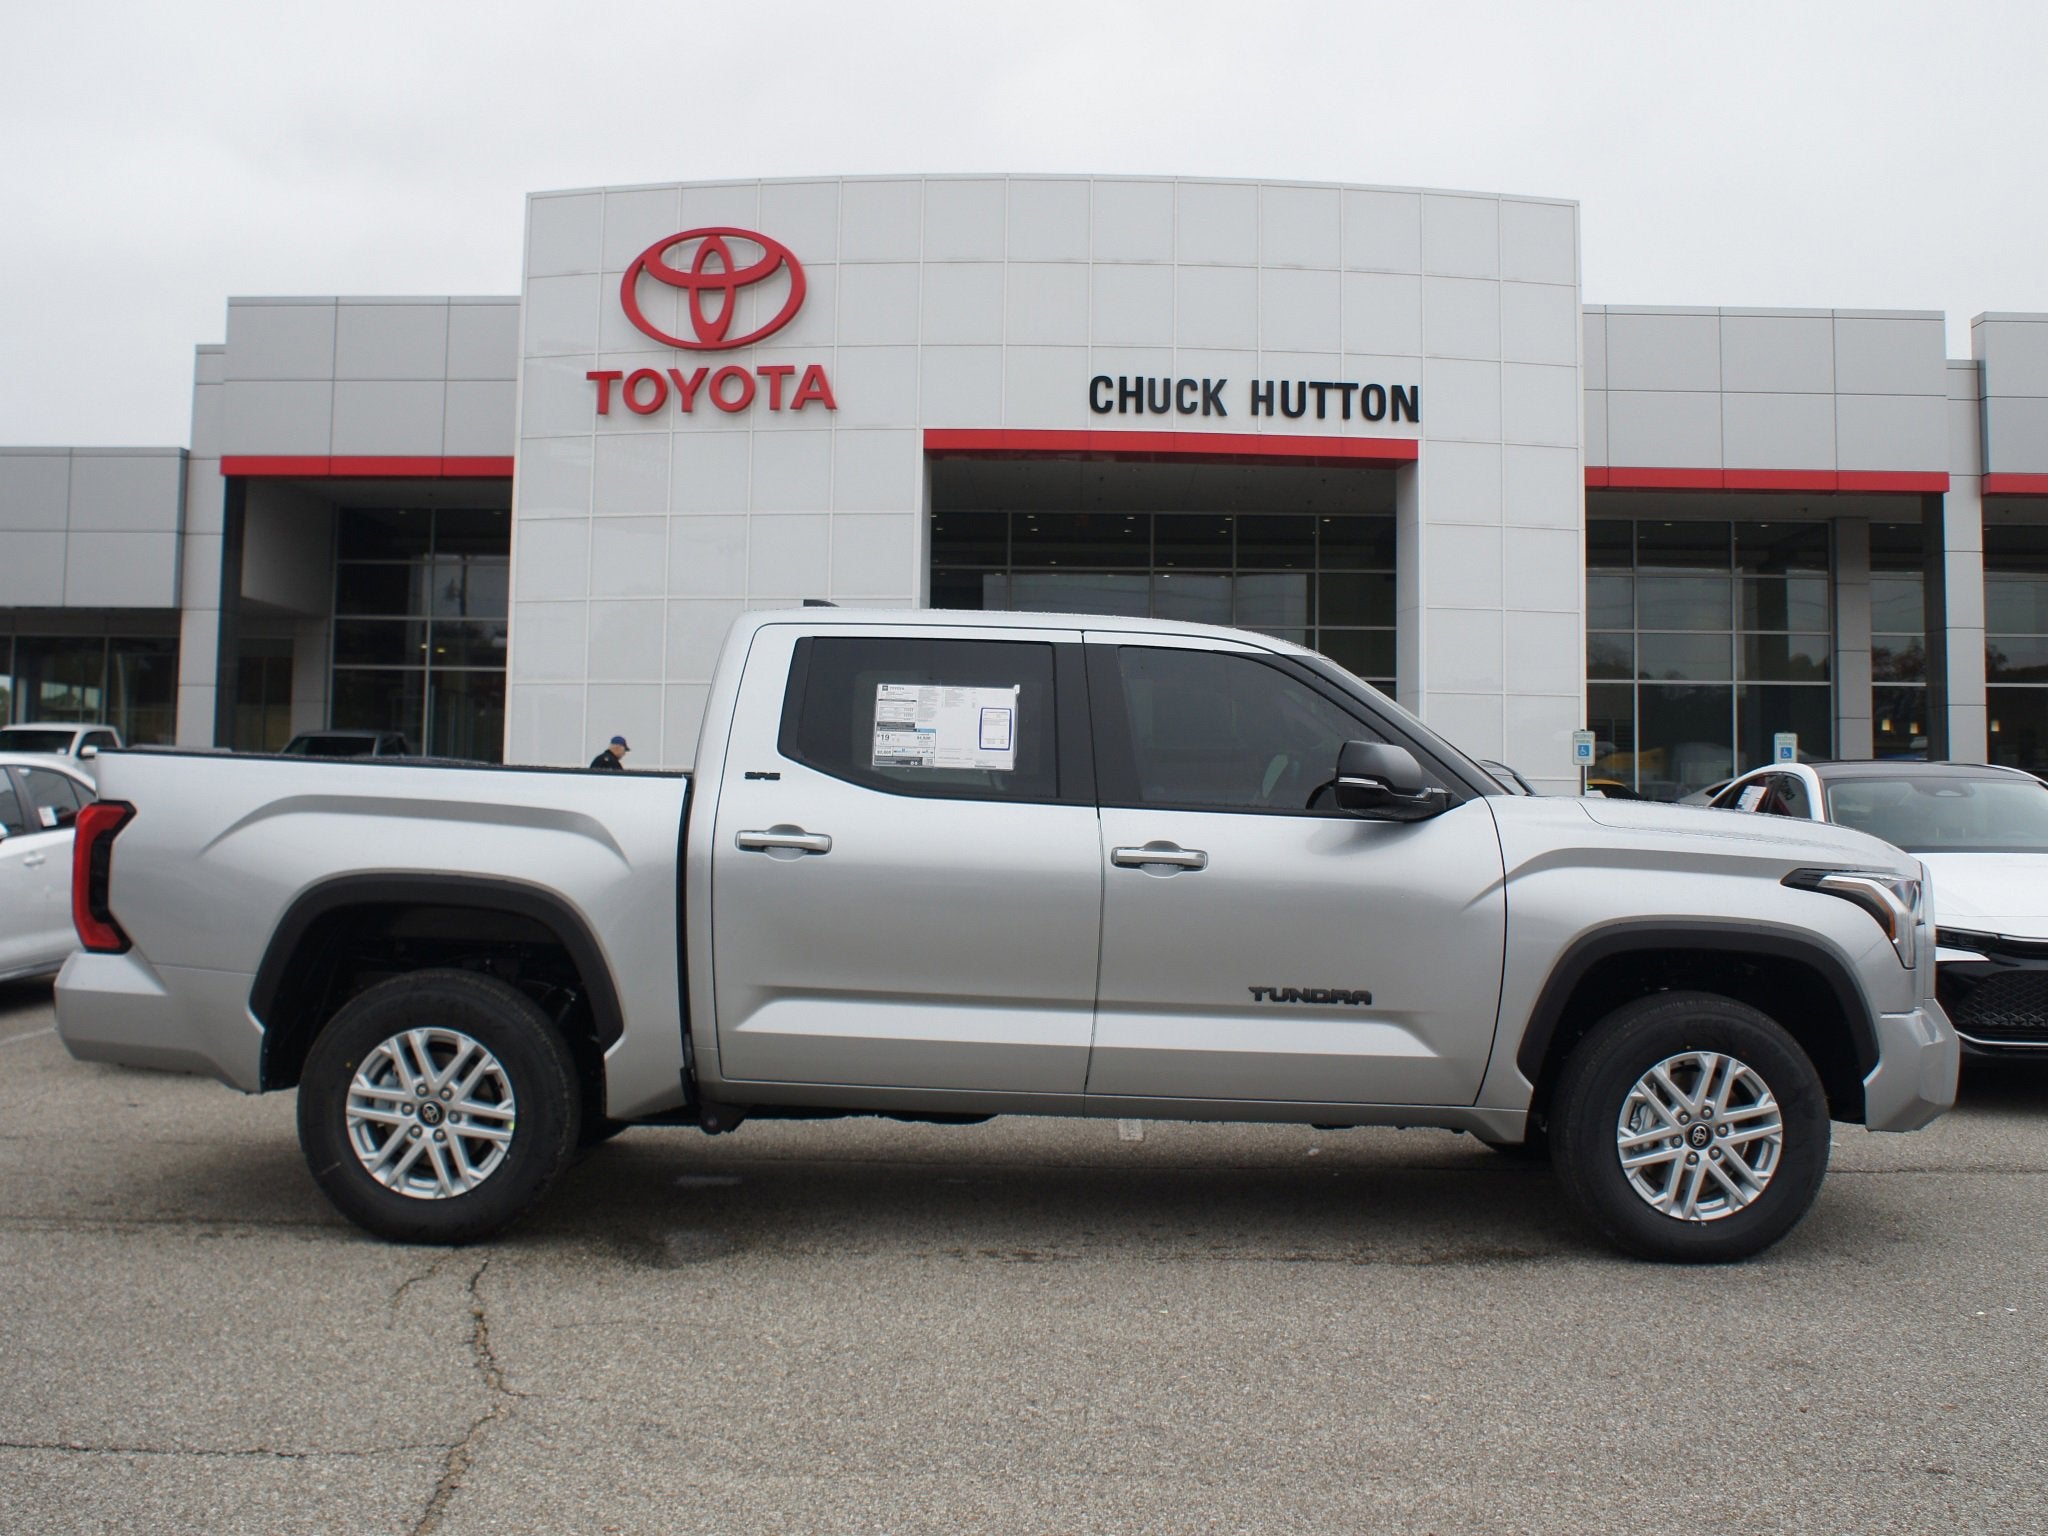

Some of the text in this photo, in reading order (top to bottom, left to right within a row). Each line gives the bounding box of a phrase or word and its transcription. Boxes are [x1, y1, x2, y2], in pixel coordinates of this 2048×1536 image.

[586, 365, 837, 415] TOYOTA
[1089, 375, 1420, 423] CHUCK HUTTON
[1247, 986, 1373, 1006] TUNDRA
